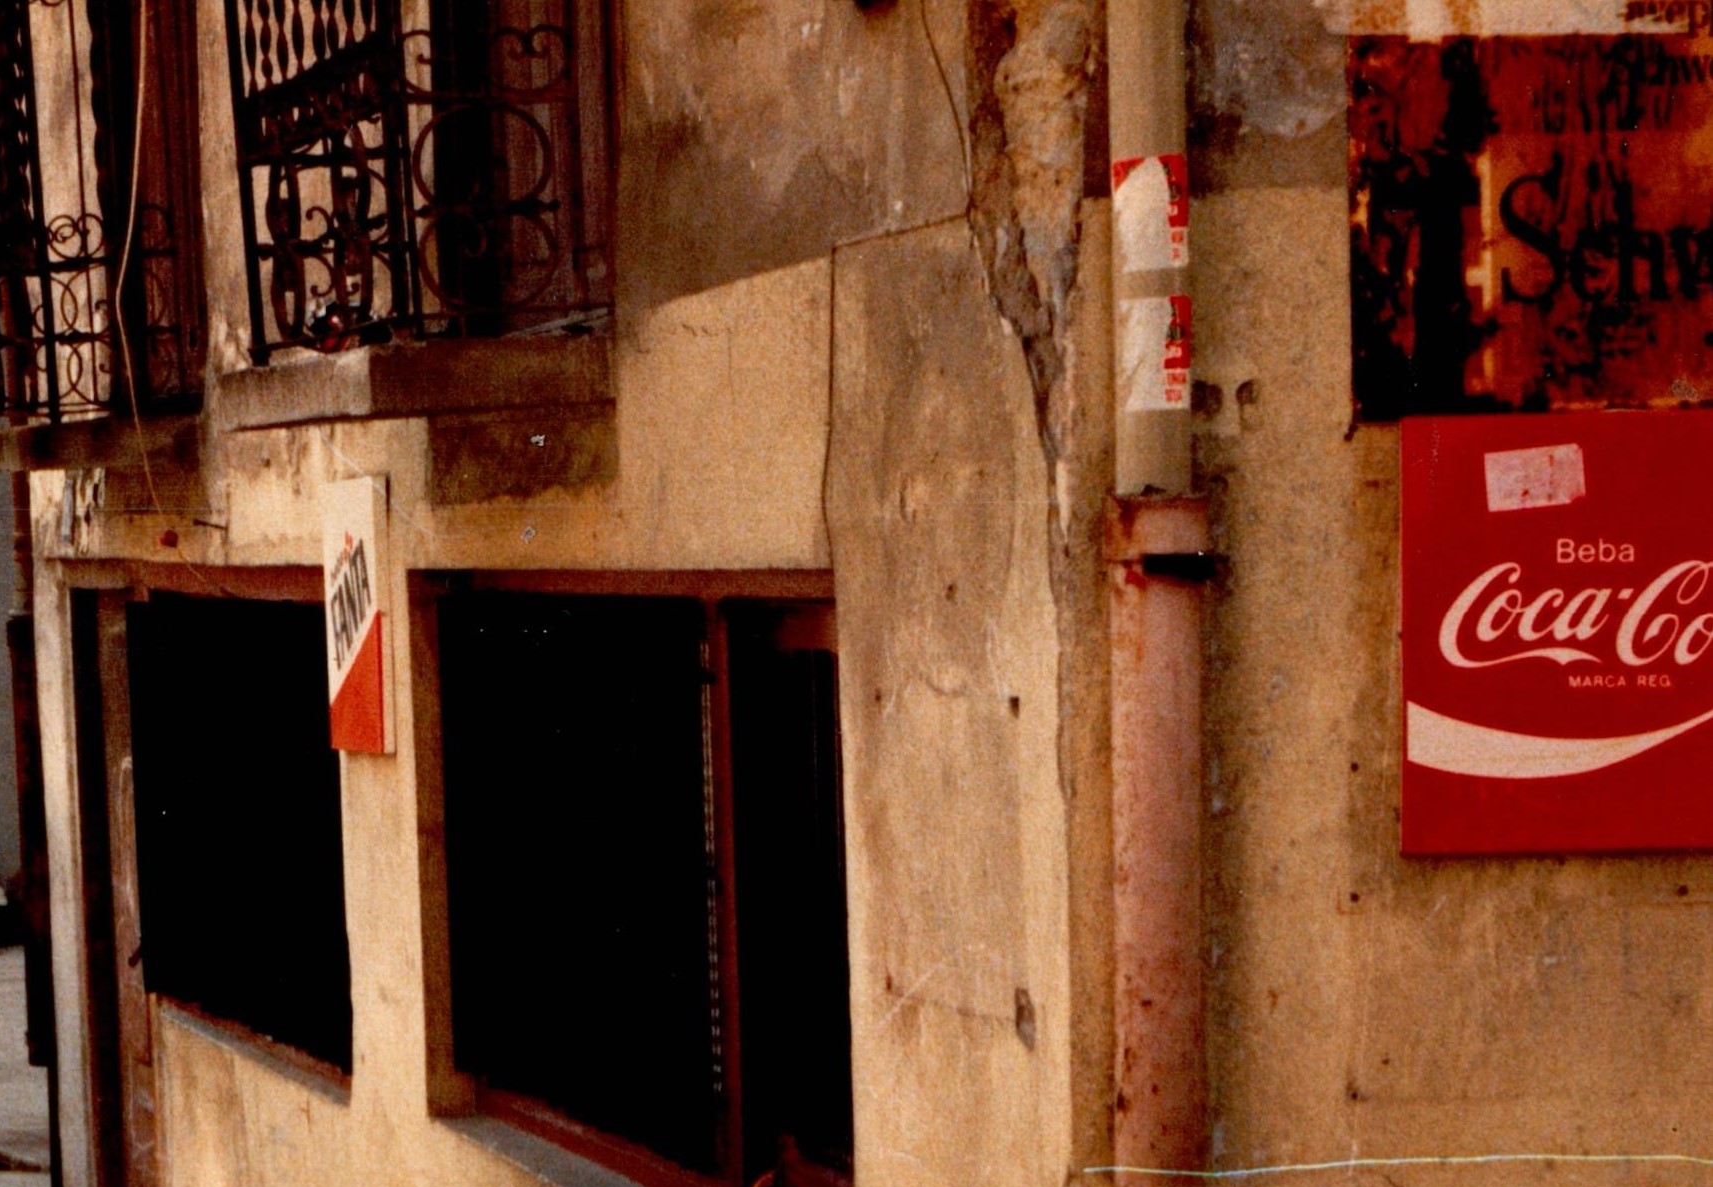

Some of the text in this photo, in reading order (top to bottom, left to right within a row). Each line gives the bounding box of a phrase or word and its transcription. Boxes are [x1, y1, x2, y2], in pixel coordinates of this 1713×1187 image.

[1556, 537, 1635, 563] Beba
[331, 539, 371, 670] FANTA
[1568, 675, 1627, 688] MARCA
